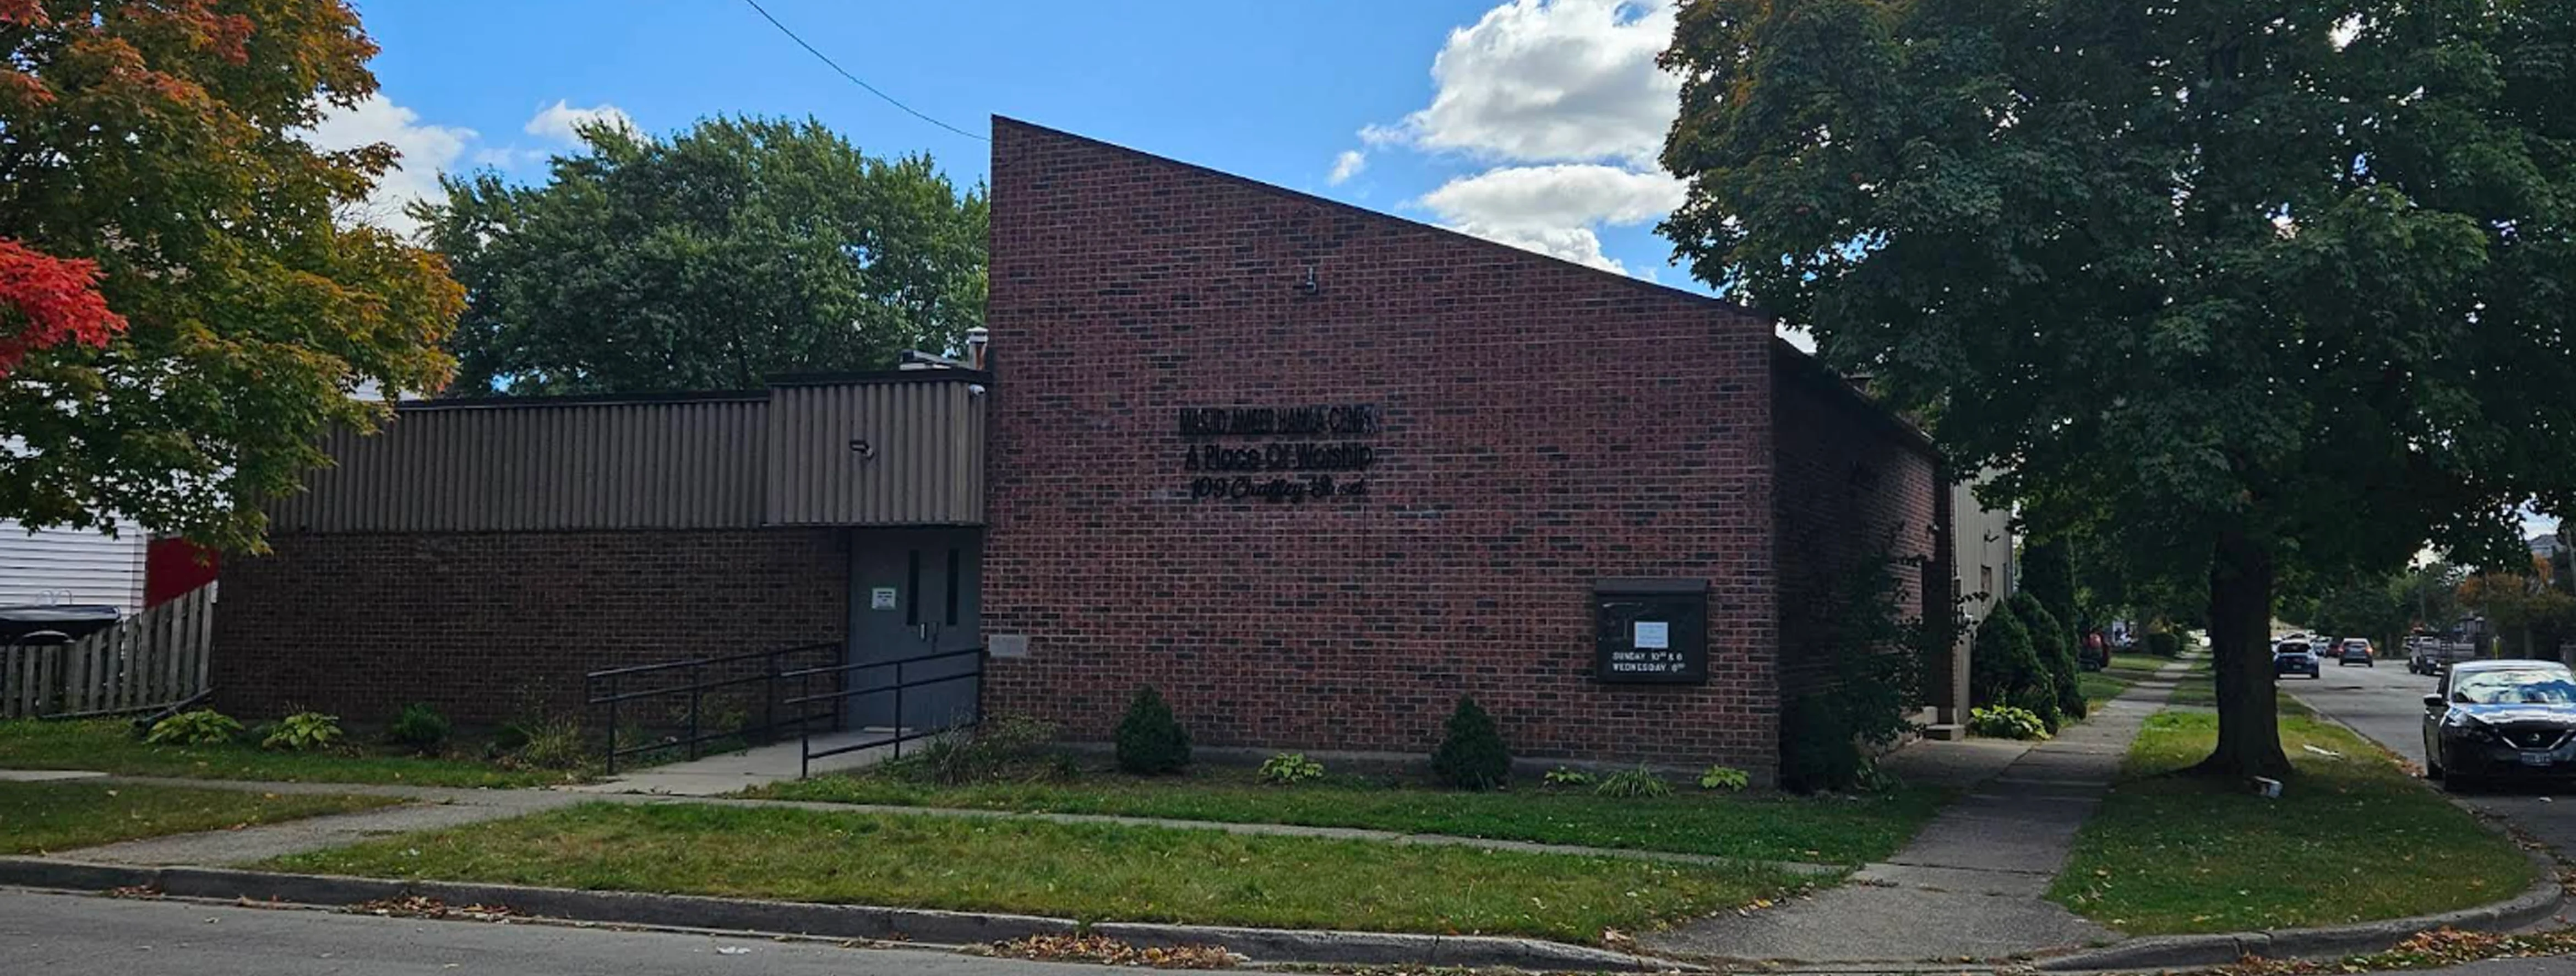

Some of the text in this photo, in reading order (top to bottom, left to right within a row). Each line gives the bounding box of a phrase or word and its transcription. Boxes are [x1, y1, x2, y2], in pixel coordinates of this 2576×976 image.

[1185, 442, 1373, 471] A Place Of Worship
[1191, 476, 1227, 500] 109
[1613, 652, 1646, 660] SUNDAY
[1613, 663, 1666, 671] WEDNESDAY
